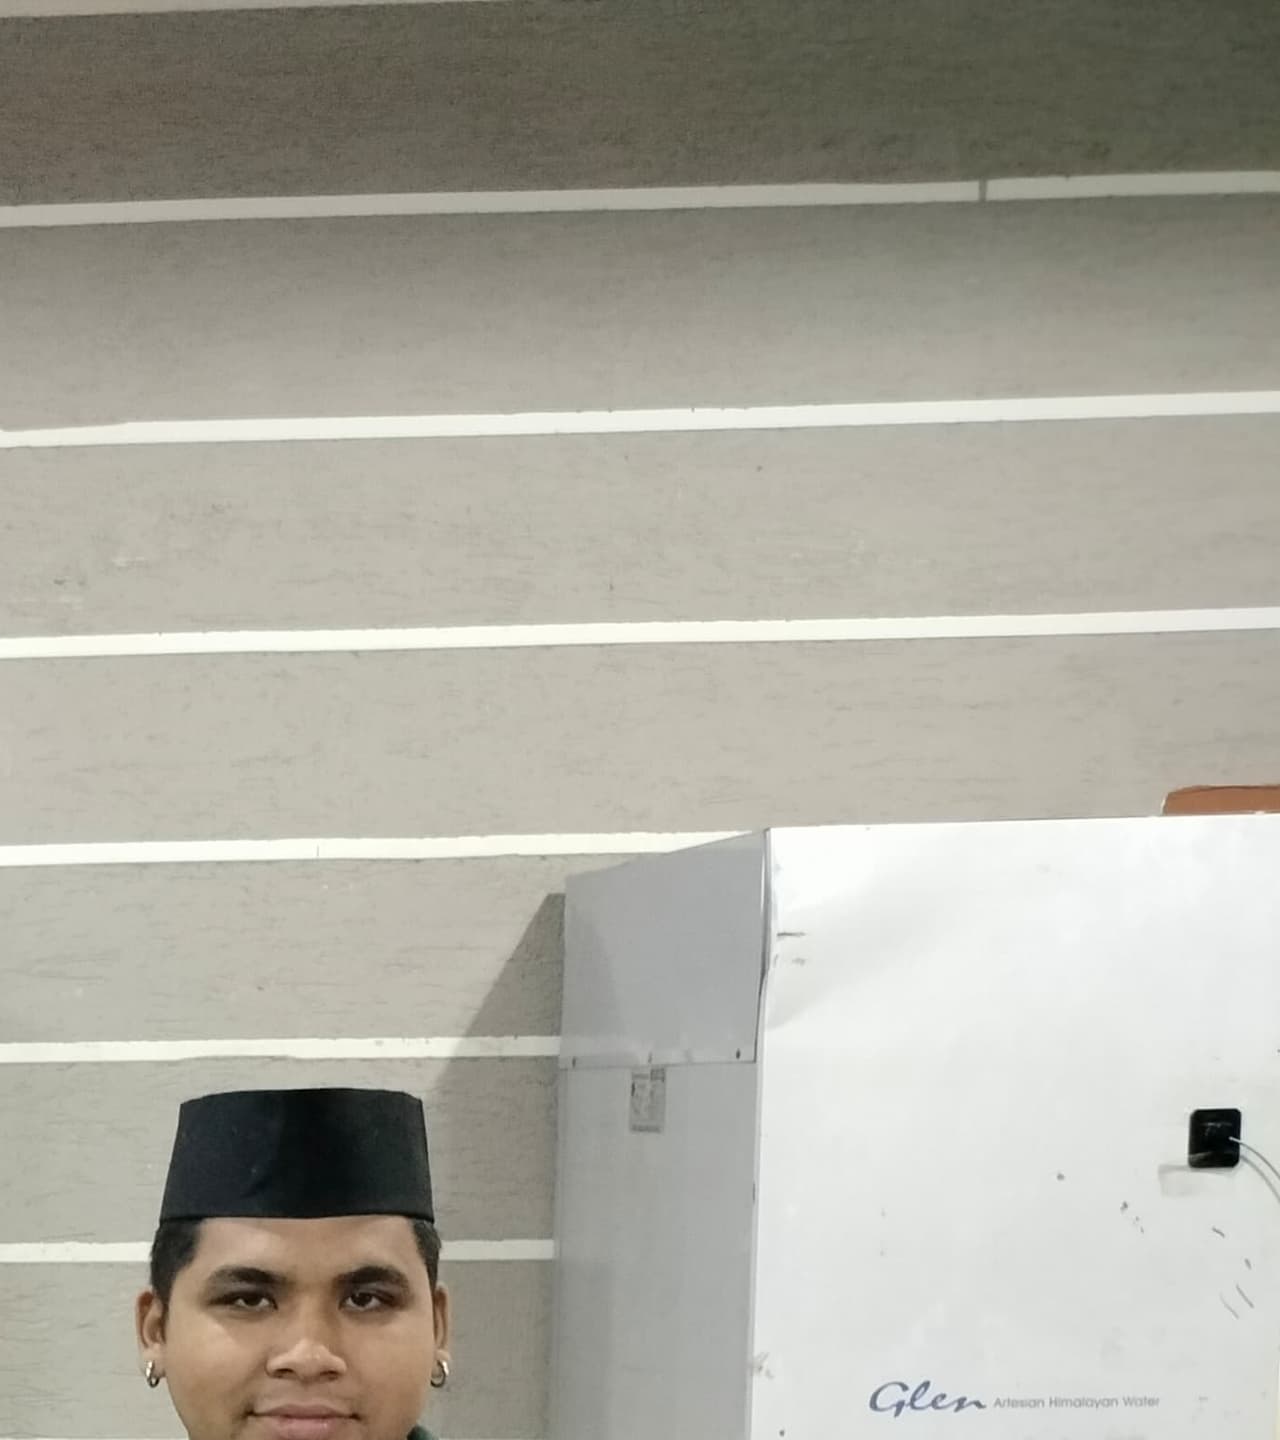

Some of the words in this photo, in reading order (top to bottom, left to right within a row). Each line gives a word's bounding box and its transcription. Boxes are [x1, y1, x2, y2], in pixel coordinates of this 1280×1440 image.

[869, 1380, 987, 1418] Glen
[993, 1396, 1045, 1409] Artesian
[1048, 1396, 1118, 1411] Himalayan
[1123, 1396, 1160, 1408] Water
